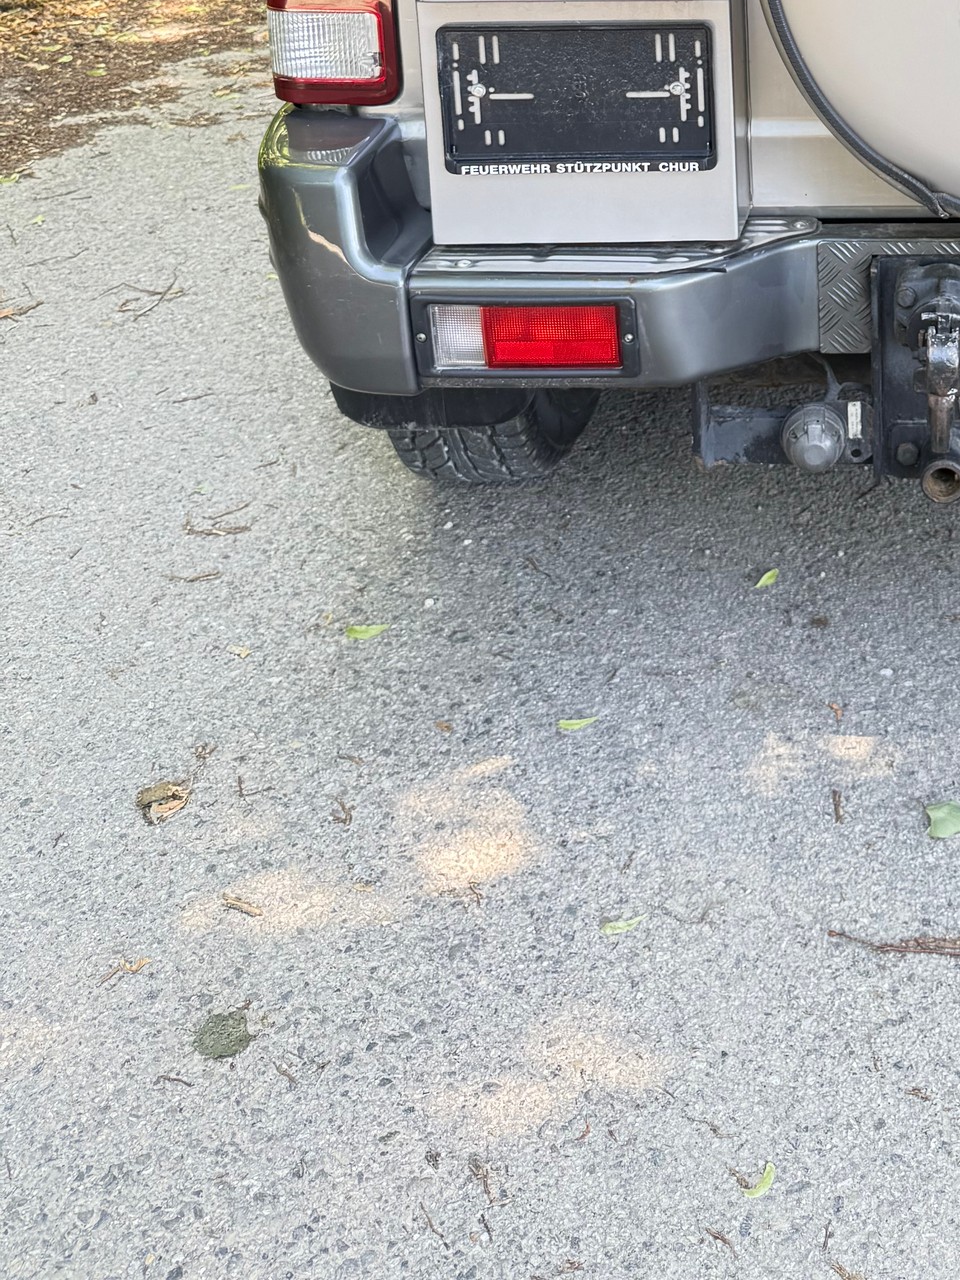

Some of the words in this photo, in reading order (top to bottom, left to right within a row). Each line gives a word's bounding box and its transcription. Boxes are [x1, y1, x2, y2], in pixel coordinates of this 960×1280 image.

[461, 164, 551, 175] FEUERWEHR
[556, 161, 650, 174] STÜTZPUNKT
[658, 162, 699, 172] CHUR
